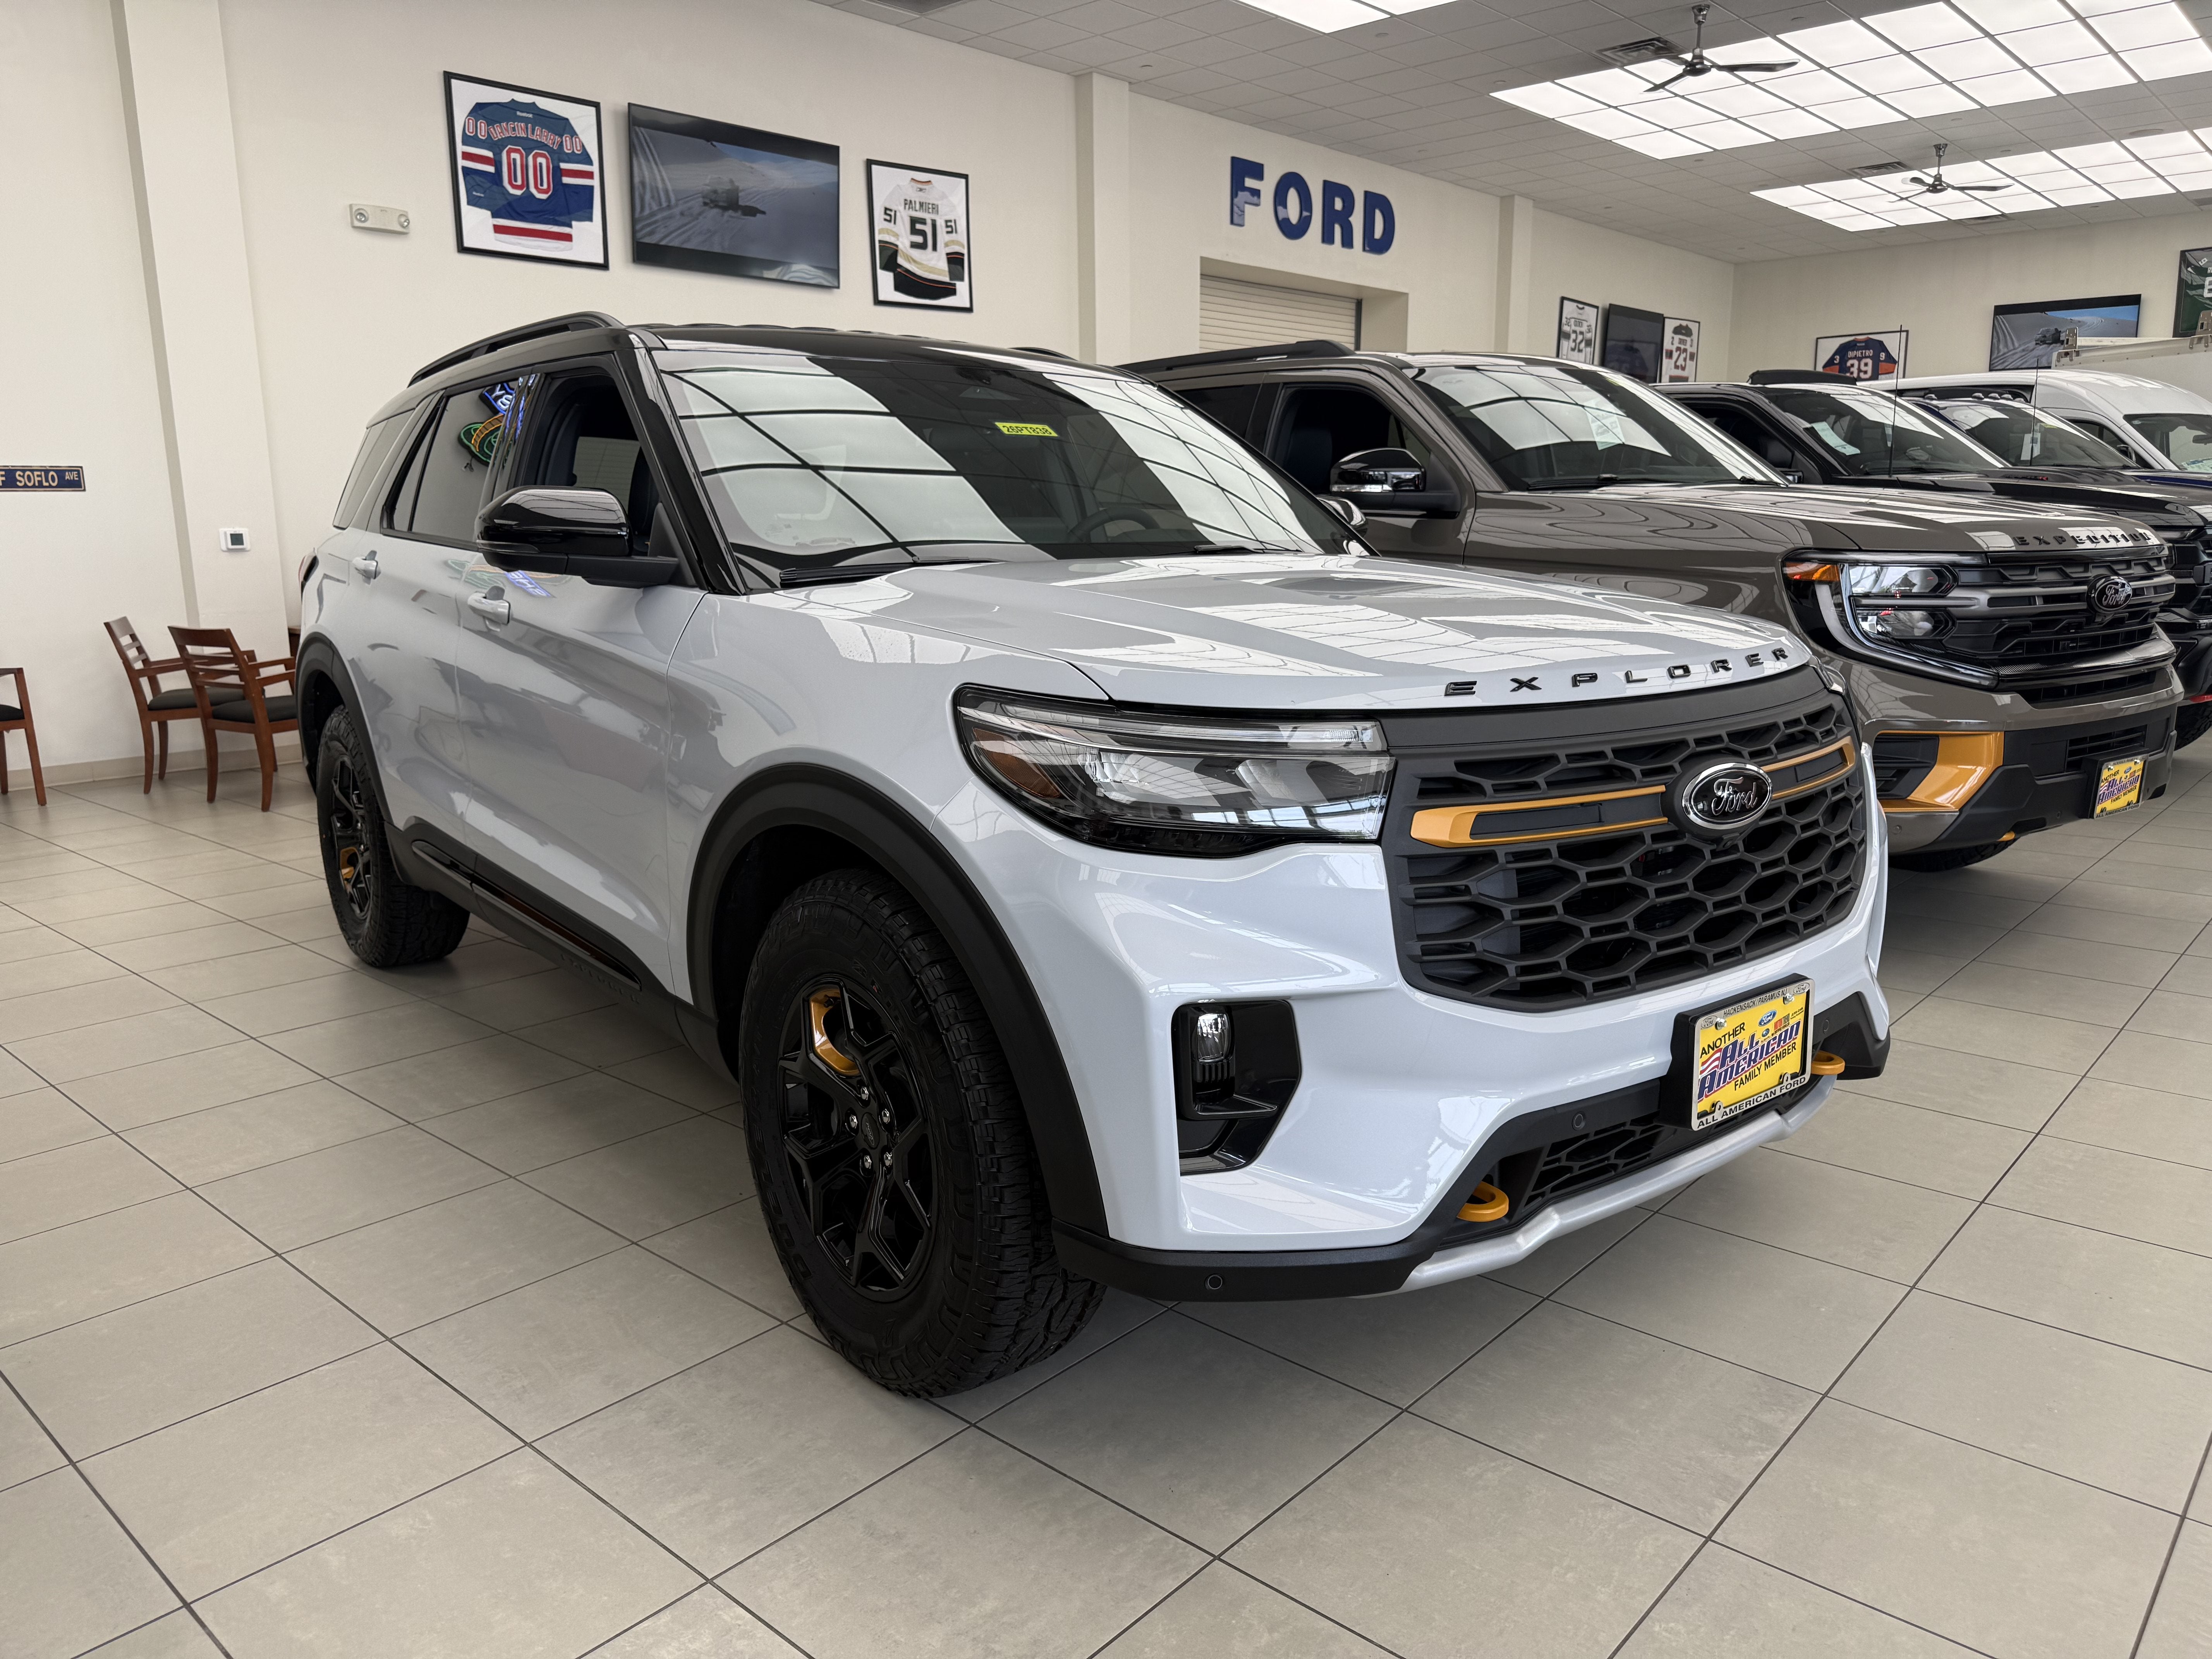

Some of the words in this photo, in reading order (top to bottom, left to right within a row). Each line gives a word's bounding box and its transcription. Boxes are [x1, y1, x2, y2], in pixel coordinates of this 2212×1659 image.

[528, 124, 562, 150] LARRY
[502, 145, 553, 200] 00
[883, 207, 896, 225] 51
[903, 199, 939, 215] PALMIERI
[1230, 156, 1395, 256] FORD
[909, 215, 937, 252] 51
[945, 219, 957, 234] 51
[1570, 329, 1584, 353] 32
[1674, 346, 1688, 371] 23
[1834, 355, 1839, 363] 3
[1848, 349, 1873, 358] DIPIETRO
[1880, 352, 1885, 361] 9
[1846, 358, 1872, 379] 39
[1002, 425, 1052, 435] 26PT838
[16, 471, 58, 486] SOFLO
[65, 471, 79, 481] AVE
[2012, 532, 2152, 546] EXPEDITION
[2102, 584, 2127, 607] Ford
[1444, 647, 1790, 696] EXPLORER
[2101, 769, 2120, 783] ANOTHER
[2107, 776, 2123, 791] ALL
[1712, 776, 1758, 816] Ford
[2111, 795, 2122, 804] FAMILY
[2123, 785, 2137, 797] MEMBER
[2105, 807, 2127, 816] AMERICAN
[1700, 1022, 1745, 1058] ANOTHER
[1719, 1032, 1760, 1071] ALL
[1735, 1064, 1761, 1091] FAMILY
[1764, 1042, 1797, 1070] MEMBER
[1697, 1115, 1718, 1128] ALL
[1721, 1089, 1776, 1118] AMERICAN
[1779, 1077, 1806, 1093] FORD
